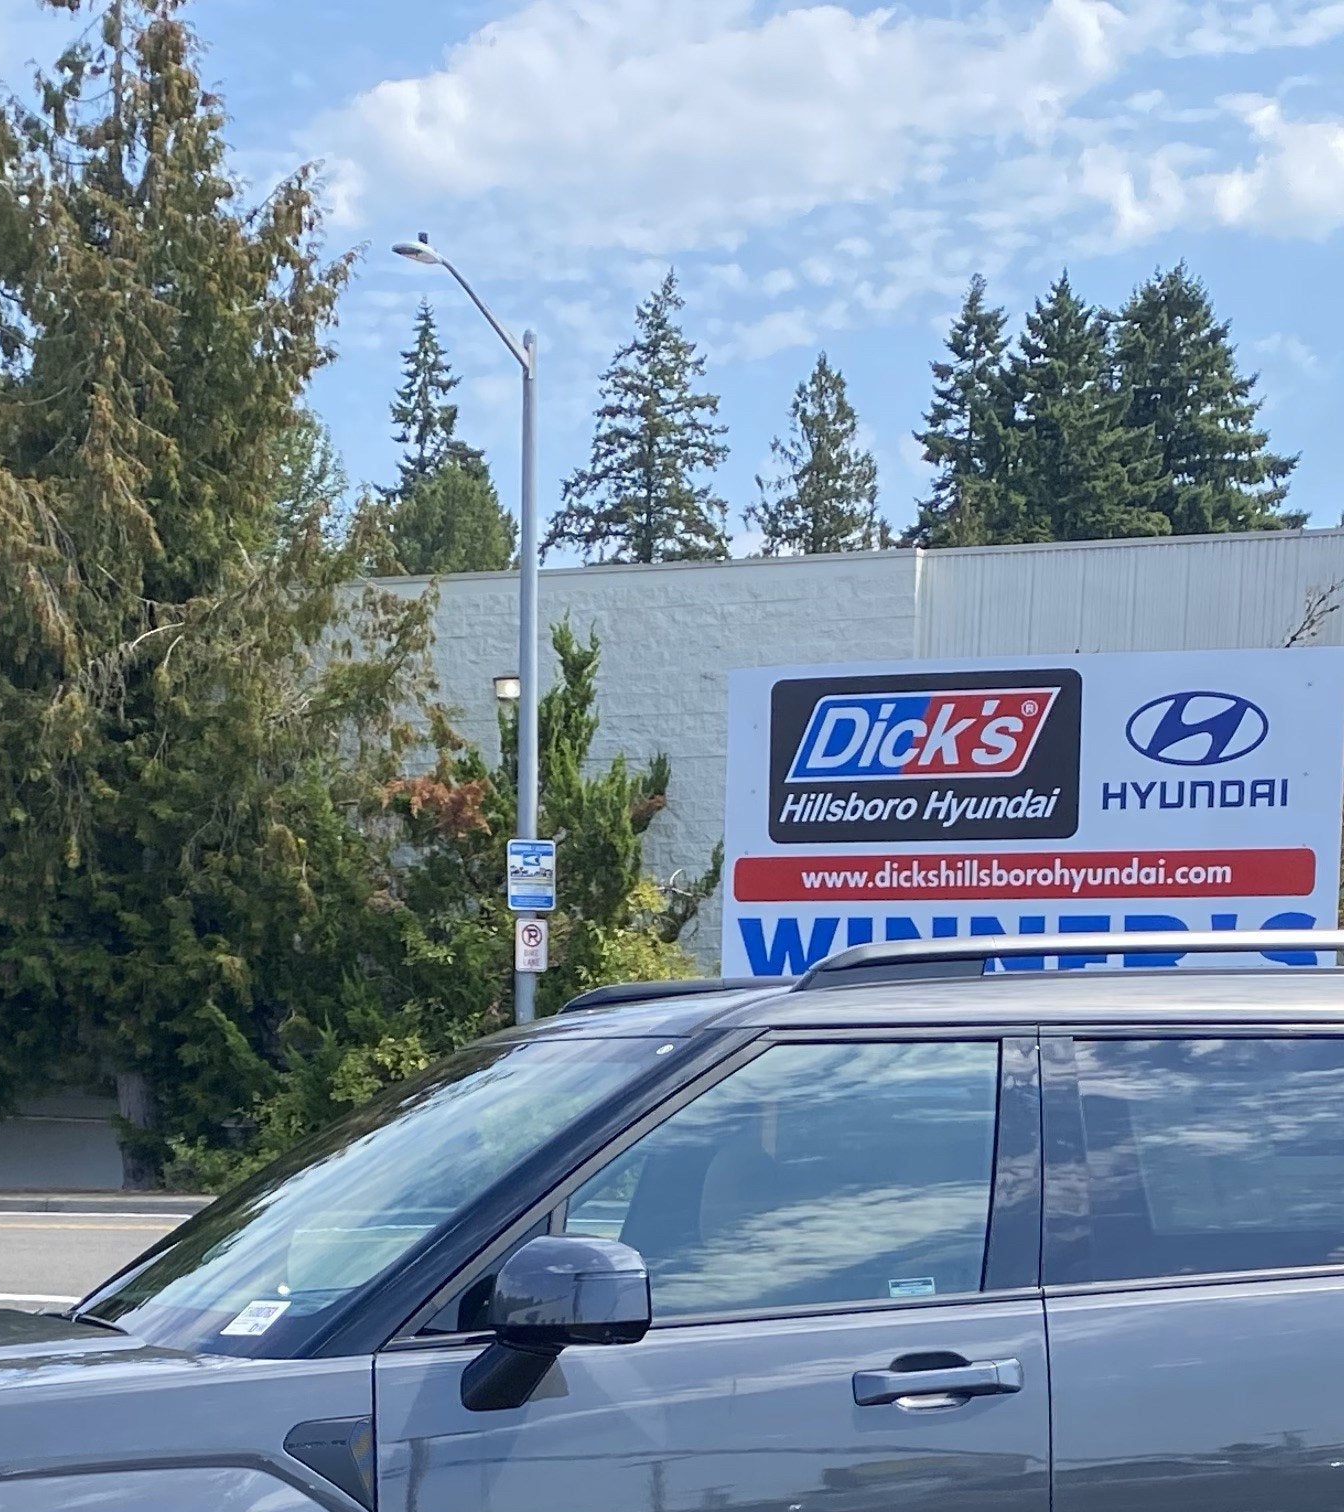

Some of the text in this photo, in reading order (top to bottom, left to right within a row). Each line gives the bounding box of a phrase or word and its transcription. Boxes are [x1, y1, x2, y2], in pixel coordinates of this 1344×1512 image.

[806, 700, 1024, 769] Dick's
[779, 787, 1062, 828] Hillsboro Hyundai
[1102, 778, 1289, 811] HYUNDAI
[801, 857, 1233, 889] www.dickshillsborohyundai.com
